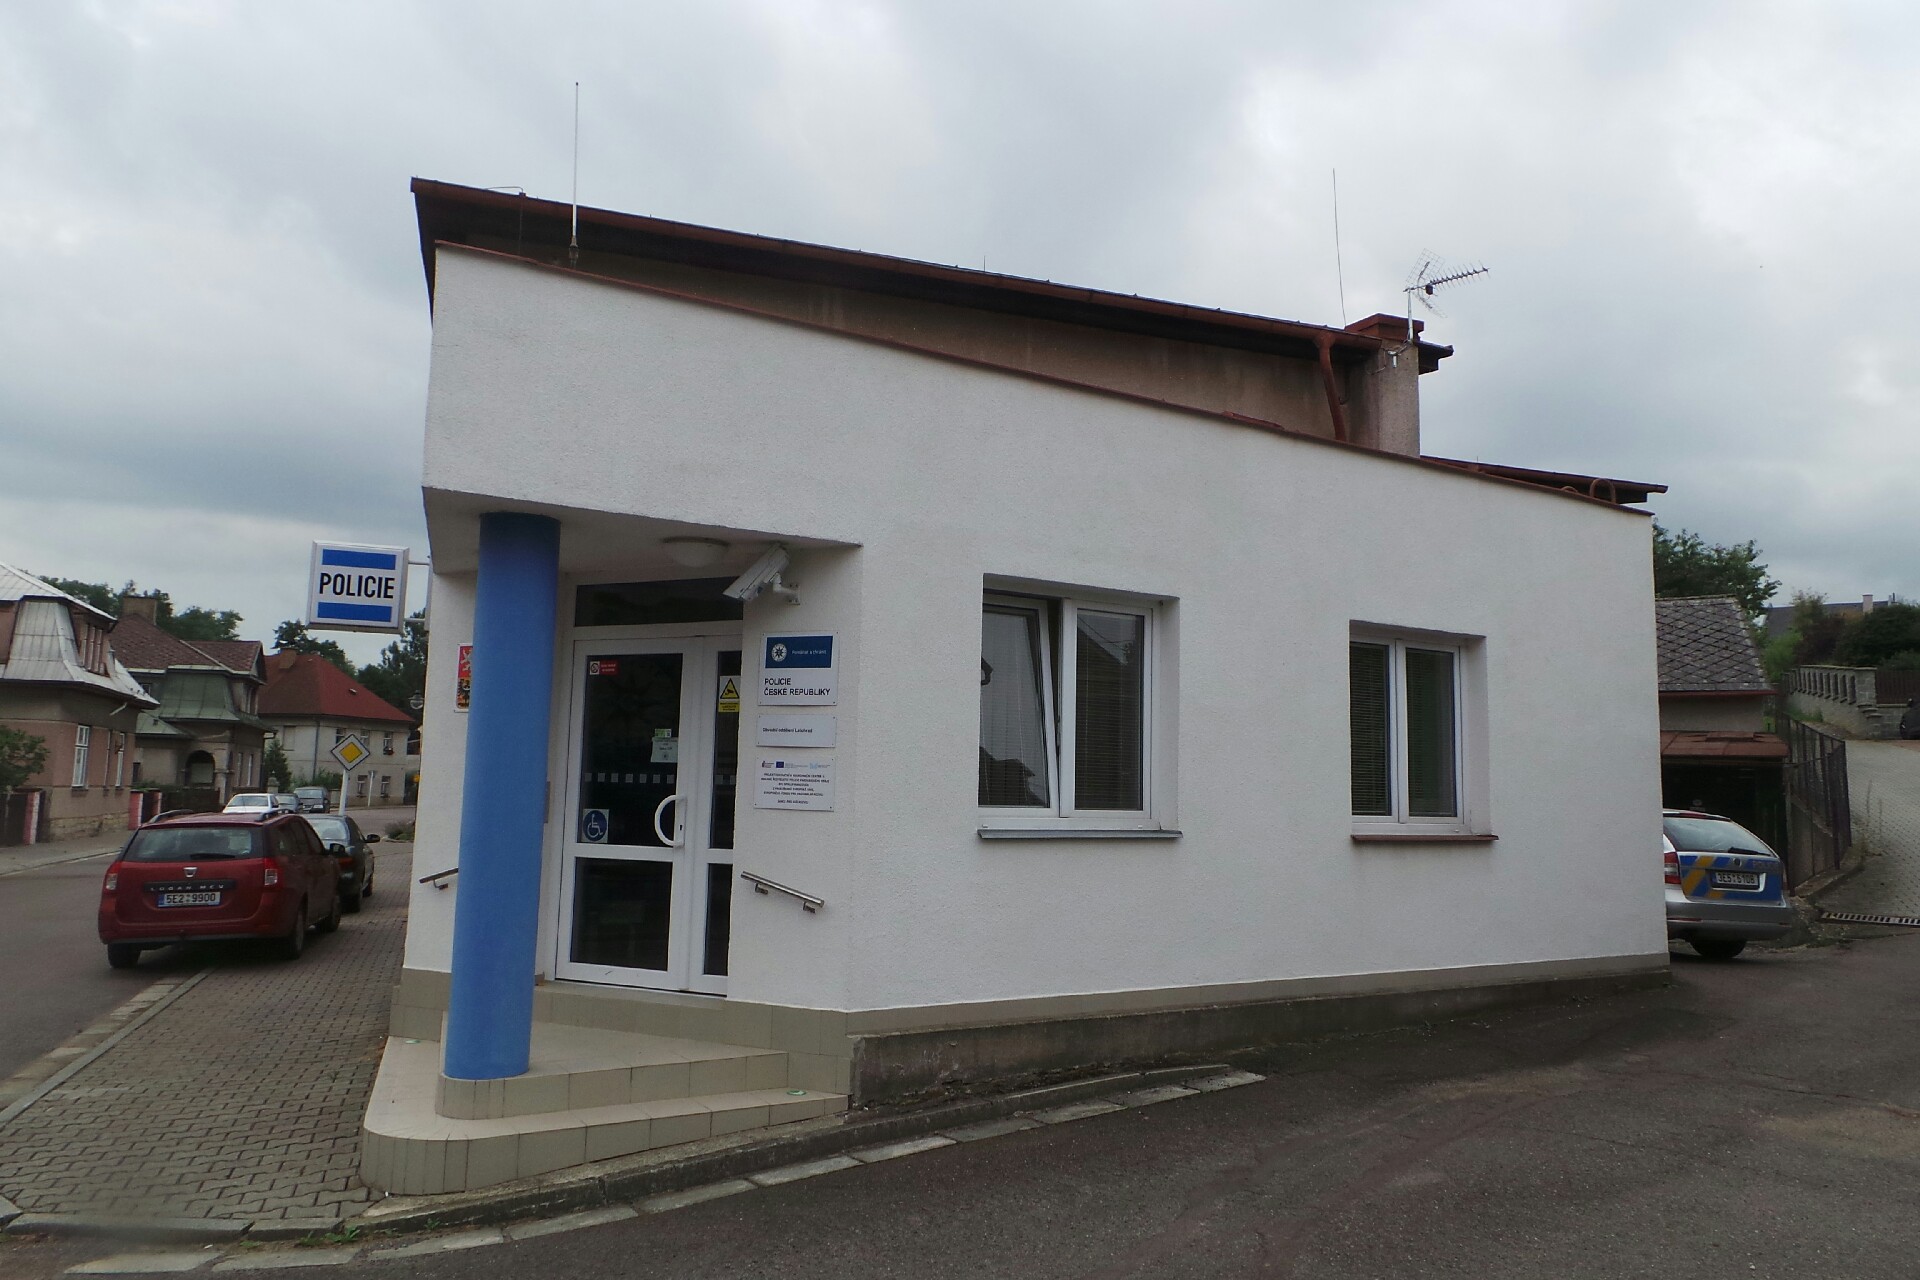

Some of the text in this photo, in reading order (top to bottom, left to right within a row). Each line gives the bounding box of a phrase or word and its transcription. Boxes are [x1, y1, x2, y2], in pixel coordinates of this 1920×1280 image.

[319, 572, 395, 599] POLICIE
[764, 677, 792, 686] POLICIE
[763, 687, 831, 696] ČESKÉ REPUBLIKY
[166, 893, 216, 904] 5E2 9900
